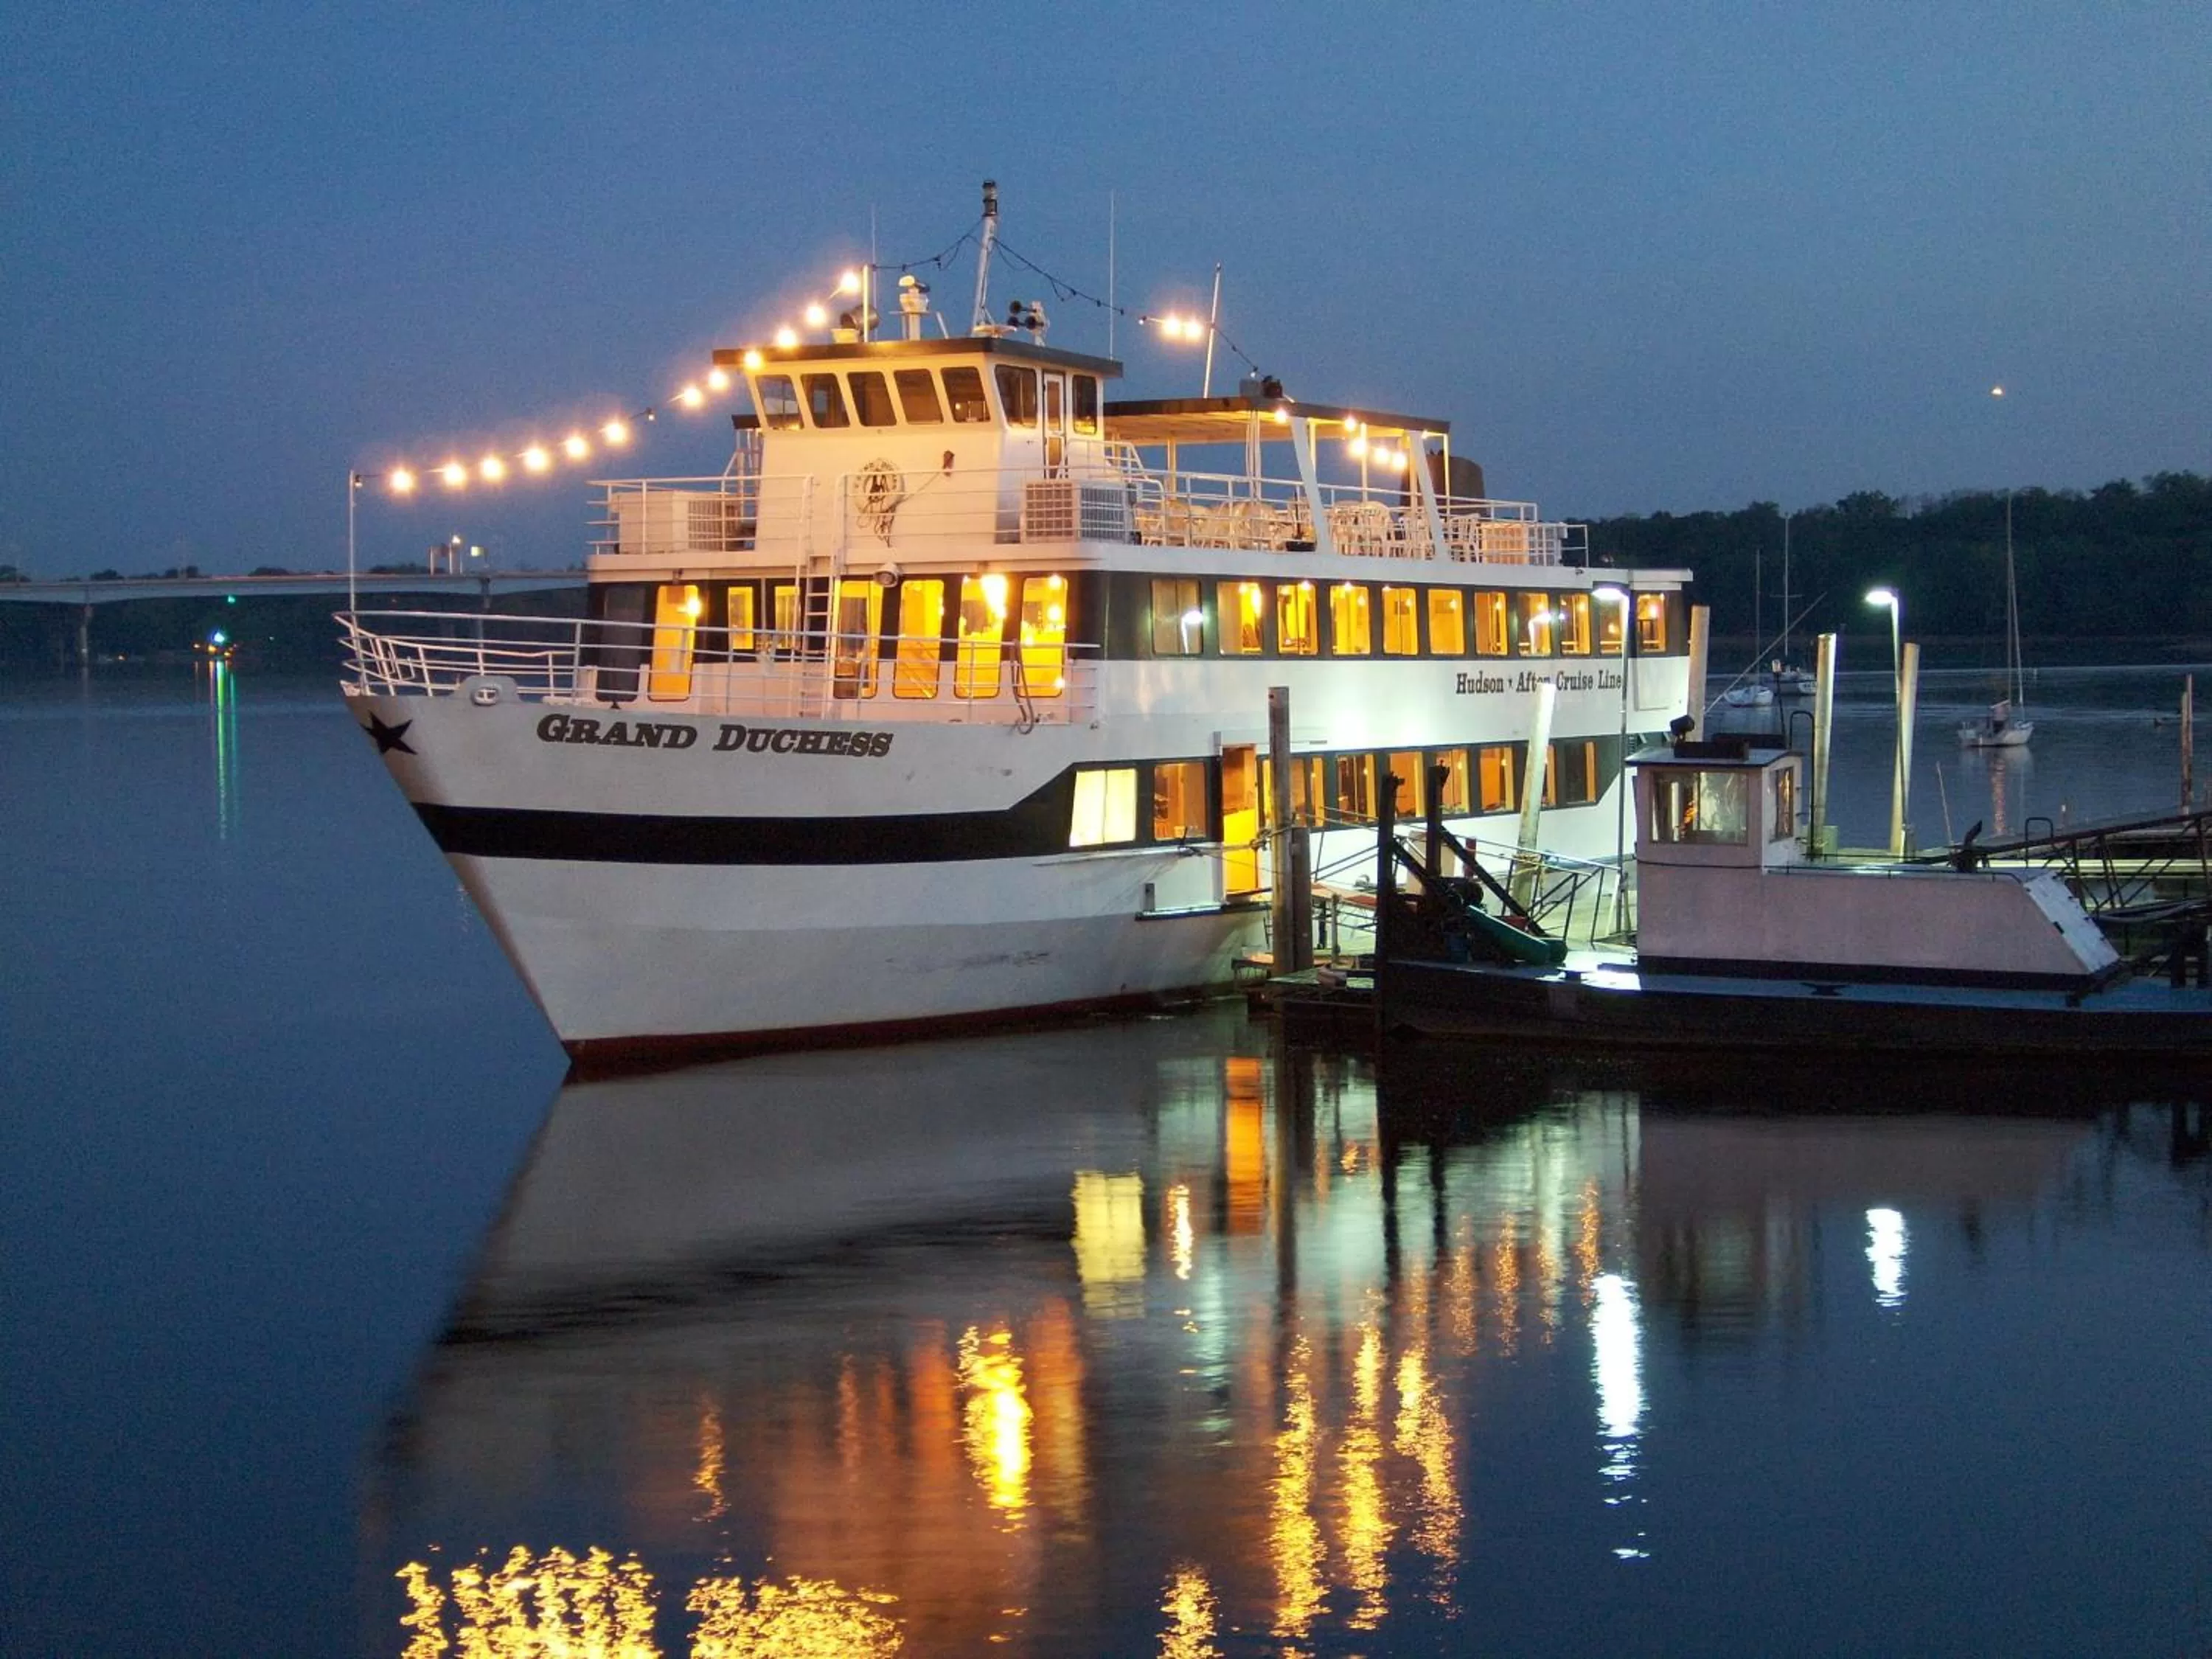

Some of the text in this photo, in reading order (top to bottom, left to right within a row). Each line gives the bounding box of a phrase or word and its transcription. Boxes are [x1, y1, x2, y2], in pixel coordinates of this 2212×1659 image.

[1455, 669, 1505, 695] Hudson
[1556, 669, 1593, 691] Cruise
[537, 713, 894, 757] GRAND DUCHESS
